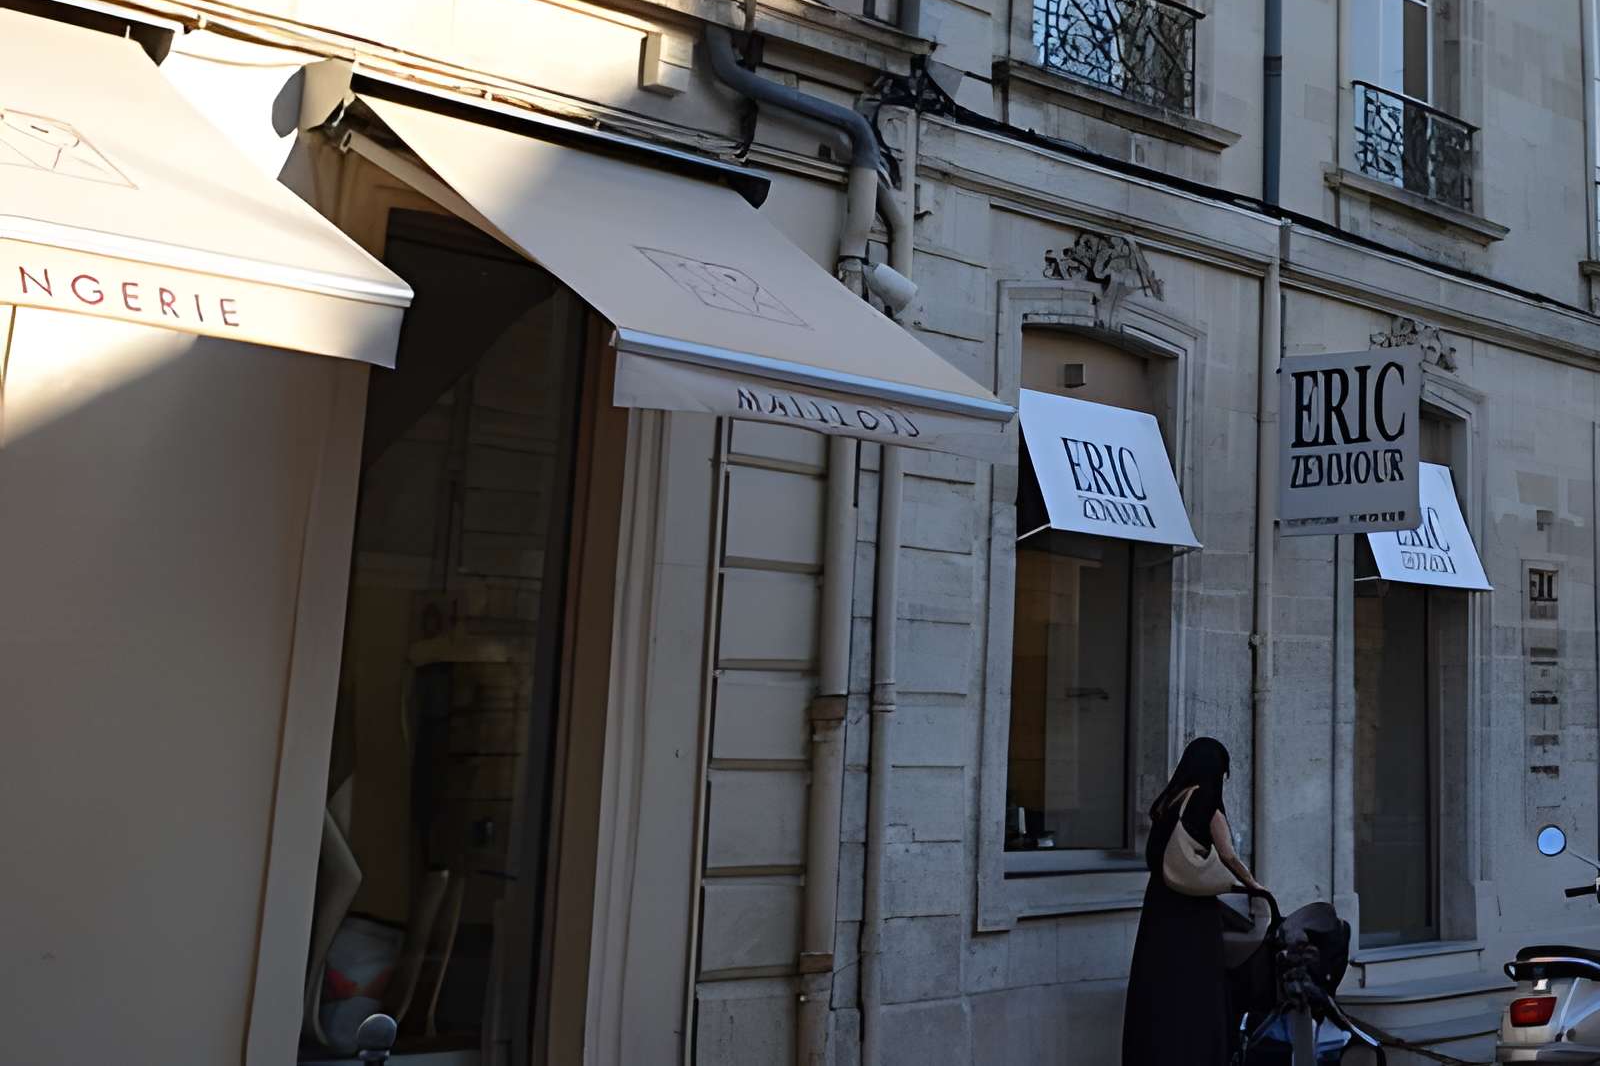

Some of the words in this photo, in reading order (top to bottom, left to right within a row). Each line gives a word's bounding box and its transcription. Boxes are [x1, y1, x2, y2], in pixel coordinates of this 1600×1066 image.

[18, 265, 240, 327] NGERIE
[1290, 361, 1406, 449] ERIC
[1060, 436, 1147, 501] ERIC
